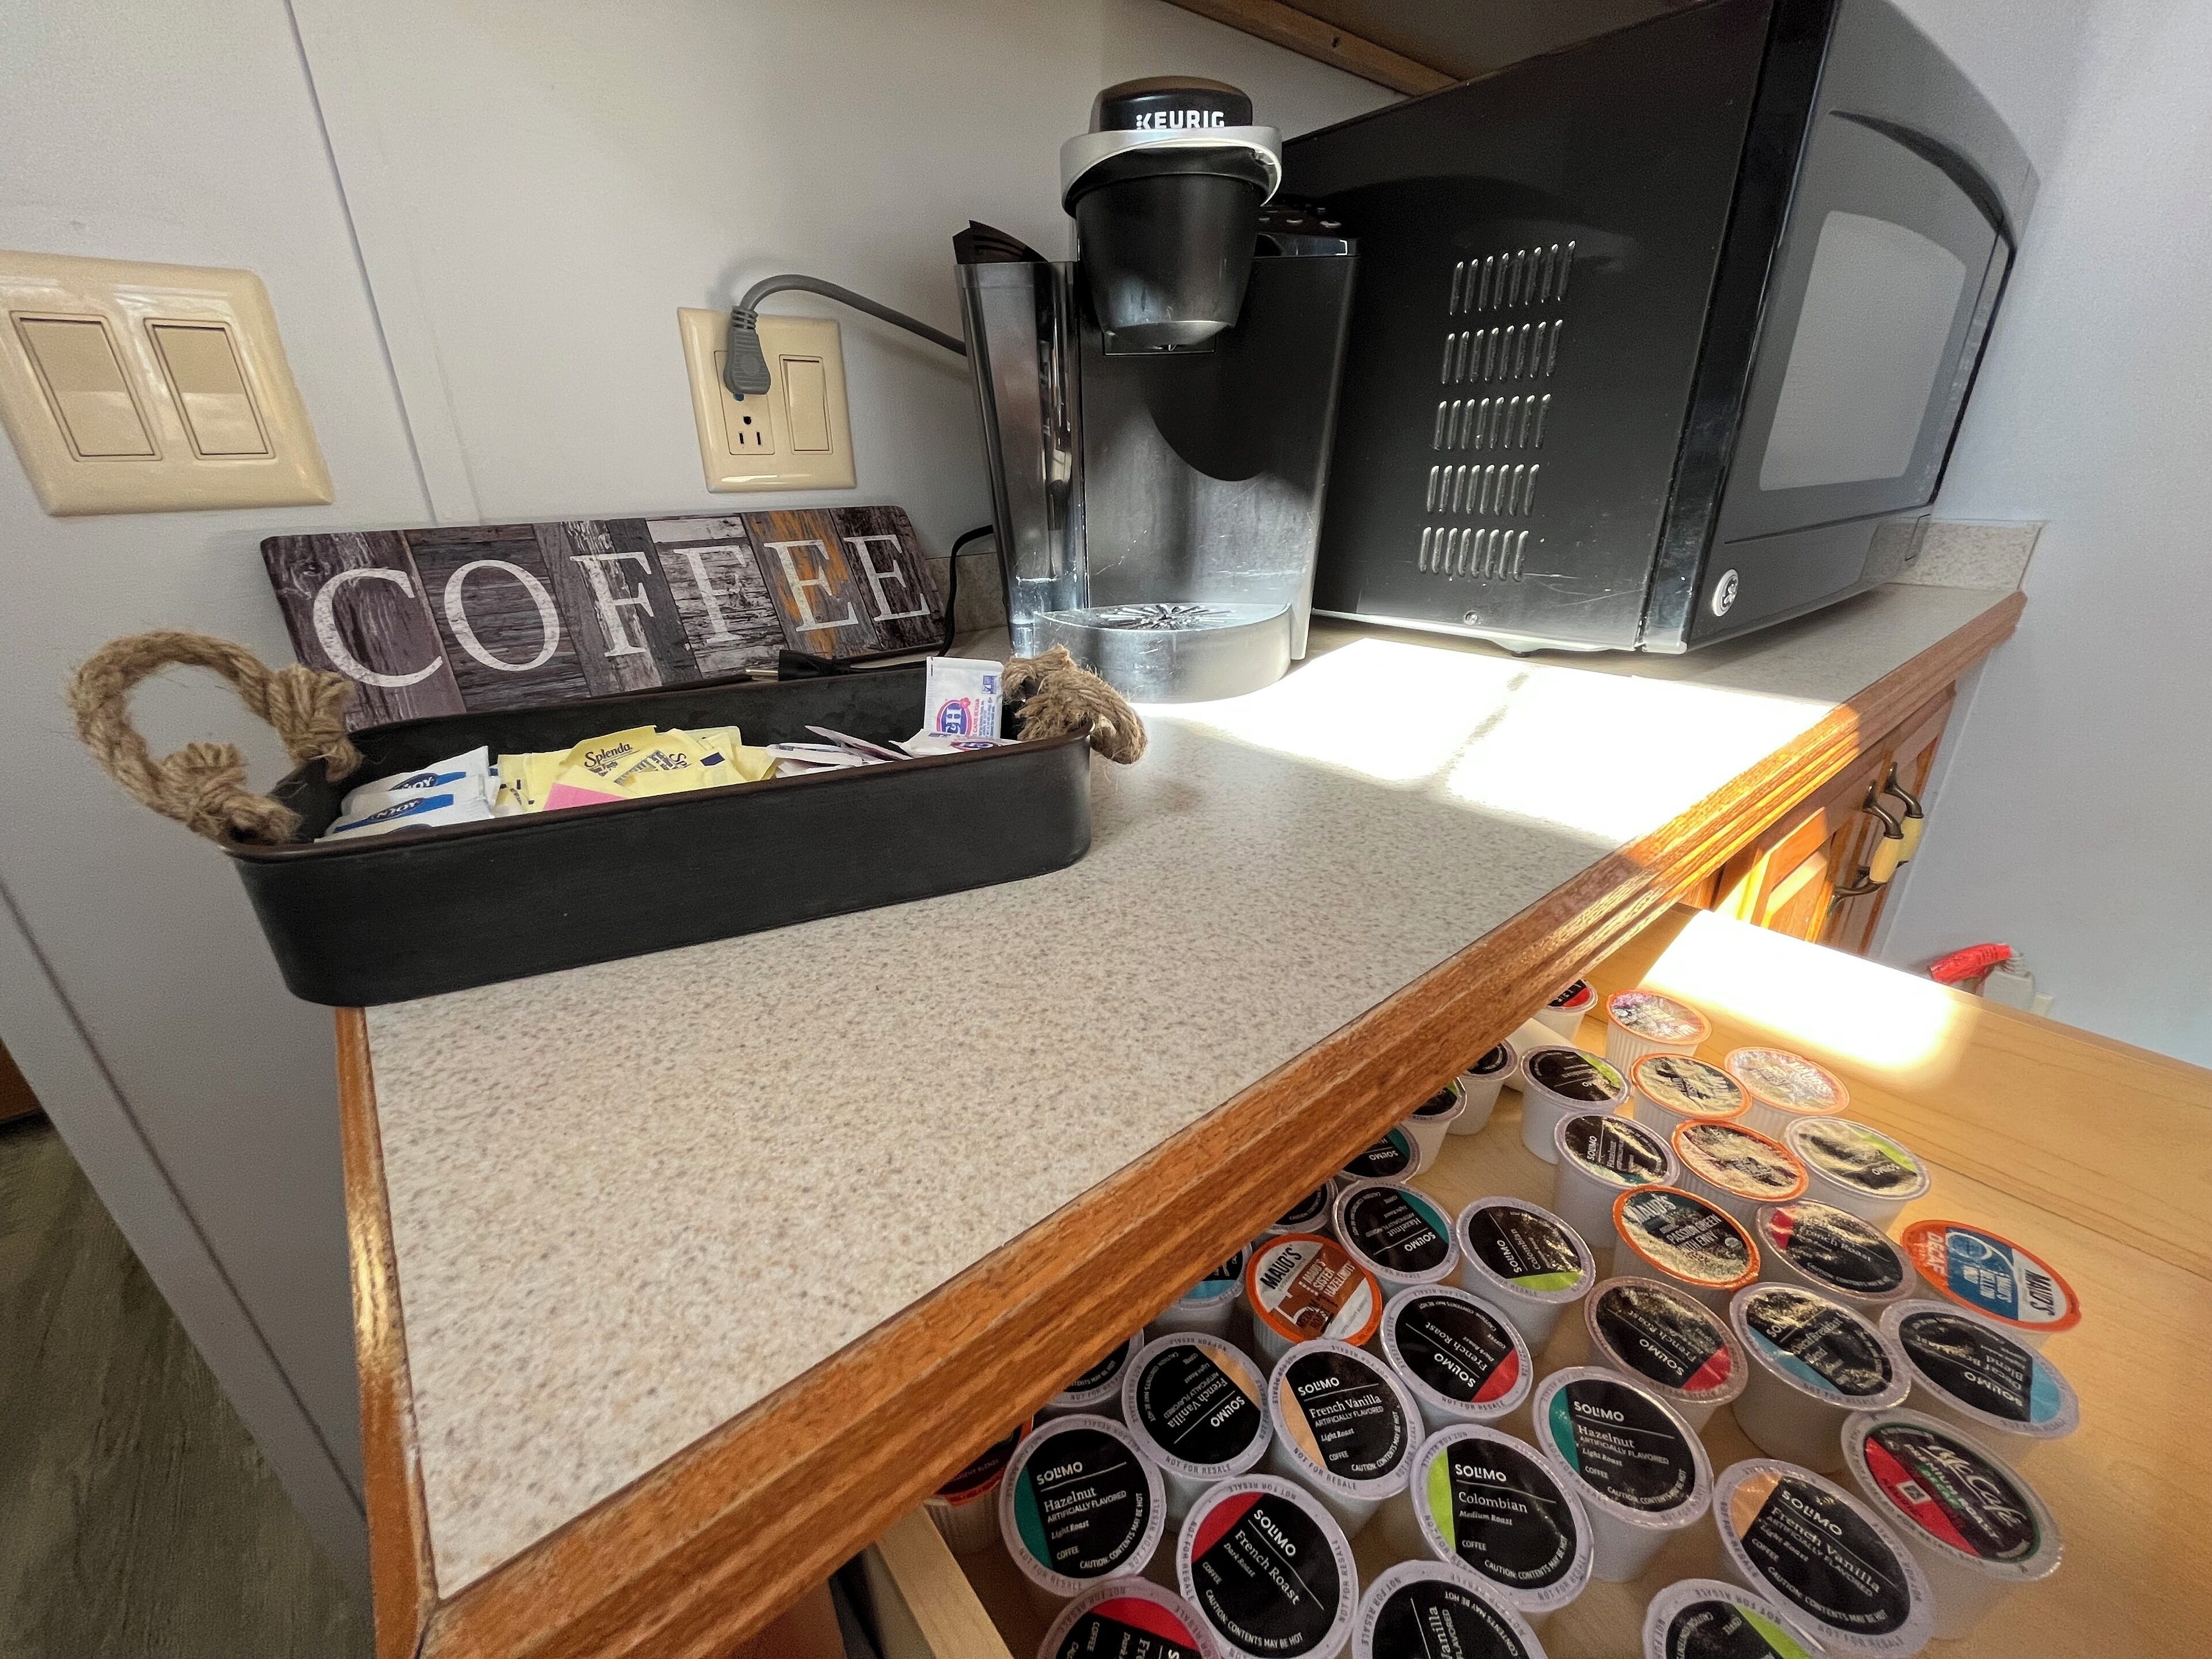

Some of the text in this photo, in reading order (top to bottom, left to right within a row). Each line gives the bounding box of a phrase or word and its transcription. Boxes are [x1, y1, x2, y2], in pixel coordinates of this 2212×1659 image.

[1136, 110, 1225, 130] KEURIG
[313, 533, 930, 688] COFFEE
[584, 742, 631, 768] Splenda
[1387, 1217, 1422, 1237] Hazelnut
[1695, 1214, 1722, 1232] GREEN
[1404, 1232, 1436, 1252] SOLIMO
[1510, 1228, 1541, 1270] Colombian
[1695, 1230, 1718, 1247] ENVY
[1841, 1240, 1872, 1262] Roast
[1497, 1239, 1522, 1274] SOLIMO
[1926, 1230, 1947, 1278] DECAF
[1259, 1247, 1302, 1290] MAUD'S
[1302, 1259, 1326, 1284] MAUD'S
[1313, 1267, 1335, 1291] SISTER
[2024, 1268, 2055, 1317] MAUD'S
[1425, 1321, 1488, 1372] French Roast
[1639, 1338, 1685, 1377] SOLIMO
[1659, 1331, 1697, 1363] French
[1434, 1353, 1476, 1388] SOLIMO
[1298, 1377, 1340, 1396] SOLIMO
[1964, 1371, 2023, 1407] SOLIMO
[1166, 1377, 1229, 1428] French Vanilla
[1210, 1396, 1245, 1427] SOLIMO
[1308, 1393, 1382, 1419] French Vanilla
[1574, 1400, 1624, 1422] SOLIMO
[1315, 1406, 1384, 1428] ARTIFICIALLY FLAVORED
[1321, 1427, 1355, 1442] Light Roast
[1577, 1425, 1636, 1449] Hazelnut
[1328, 1450, 1349, 1461] COFFEE
[1376, 1445, 1397, 1468] CONTENTS
[1580, 1437, 1669, 1465] ARTIFICIALLY FLAVORED
[1582, 1447, 1601, 1460] Light
[1036, 1461, 1083, 1486] SOLIMO
[1202, 1463, 1231, 1475] RESALE
[1455, 1463, 1507, 1482] SOLIMO
[1585, 1465, 1609, 1479] COFFEE
[1043, 1486, 1097, 1513] Hazelnut
[1047, 1490, 1127, 1523] ARTIFICIALLY FLAVORED
[1458, 1491, 1529, 1514] Colombian
[1459, 1510, 1513, 1526] Medium Roast
[1781, 1490, 1843, 1536] SOLIMO
[1051, 1520, 1090, 1540] Light Roast
[1253, 1509, 1297, 1556] SOLIMO
[1056, 1546, 1080, 1560] COFFEE
[1080, 1556, 1109, 1569] CAUTION:
[1109, 1530, 1136, 1560] CONTENTS
[1461, 1539, 1487, 1551] COFFEE
[1751, 1538, 1780, 1563] COFFEE
[1771, 1506, 1880, 1593] French Vanilla
[1202, 1561, 1222, 1585] COFFEE
[1224, 1543, 1256, 1578] Dark Roast
[1234, 1529, 1300, 1605] French Roast
[1484, 1559, 1517, 1579] CAUTION:
[1517, 1563, 1552, 1580] CONTENTS
[1824, 1555, 1873, 1597] FLAVORED
[1445, 1590, 1460, 1602] HOT
[1206, 1589, 1228, 1624] CAUTION:
[1228, 1620, 1263, 1647] CONTENTS
[1264, 1638, 1279, 1649] MAY
[1288, 1632, 1304, 1645] HOT
